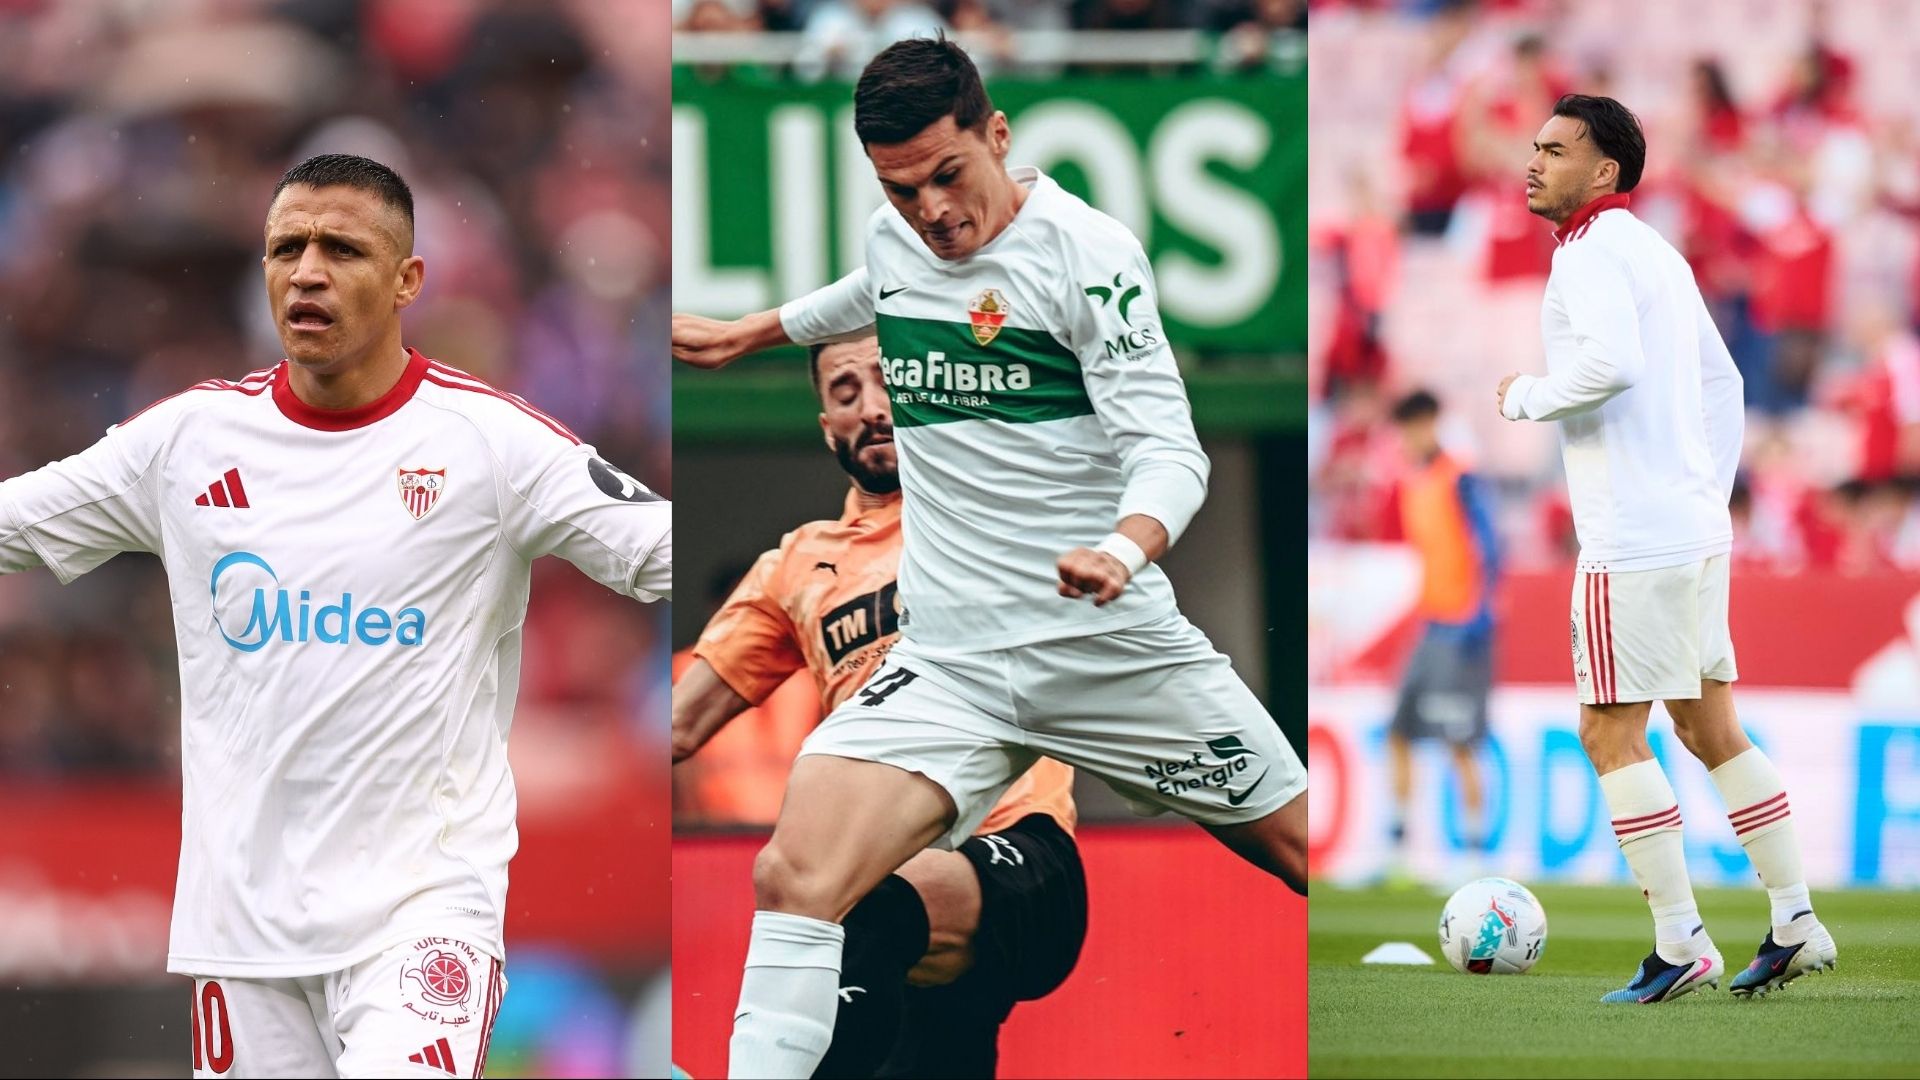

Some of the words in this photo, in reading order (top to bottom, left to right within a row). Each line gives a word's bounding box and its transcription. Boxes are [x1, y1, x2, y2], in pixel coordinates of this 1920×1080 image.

[1104, 329, 1157, 359] MCS
[931, 393, 949, 404] LA
[952, 395, 990, 407] FIBRA
[210, 551, 426, 652] Midea
[826, 608, 868, 651] TM
[1144, 752, 1205, 779] Next
[191, 979, 234, 1074] 10
